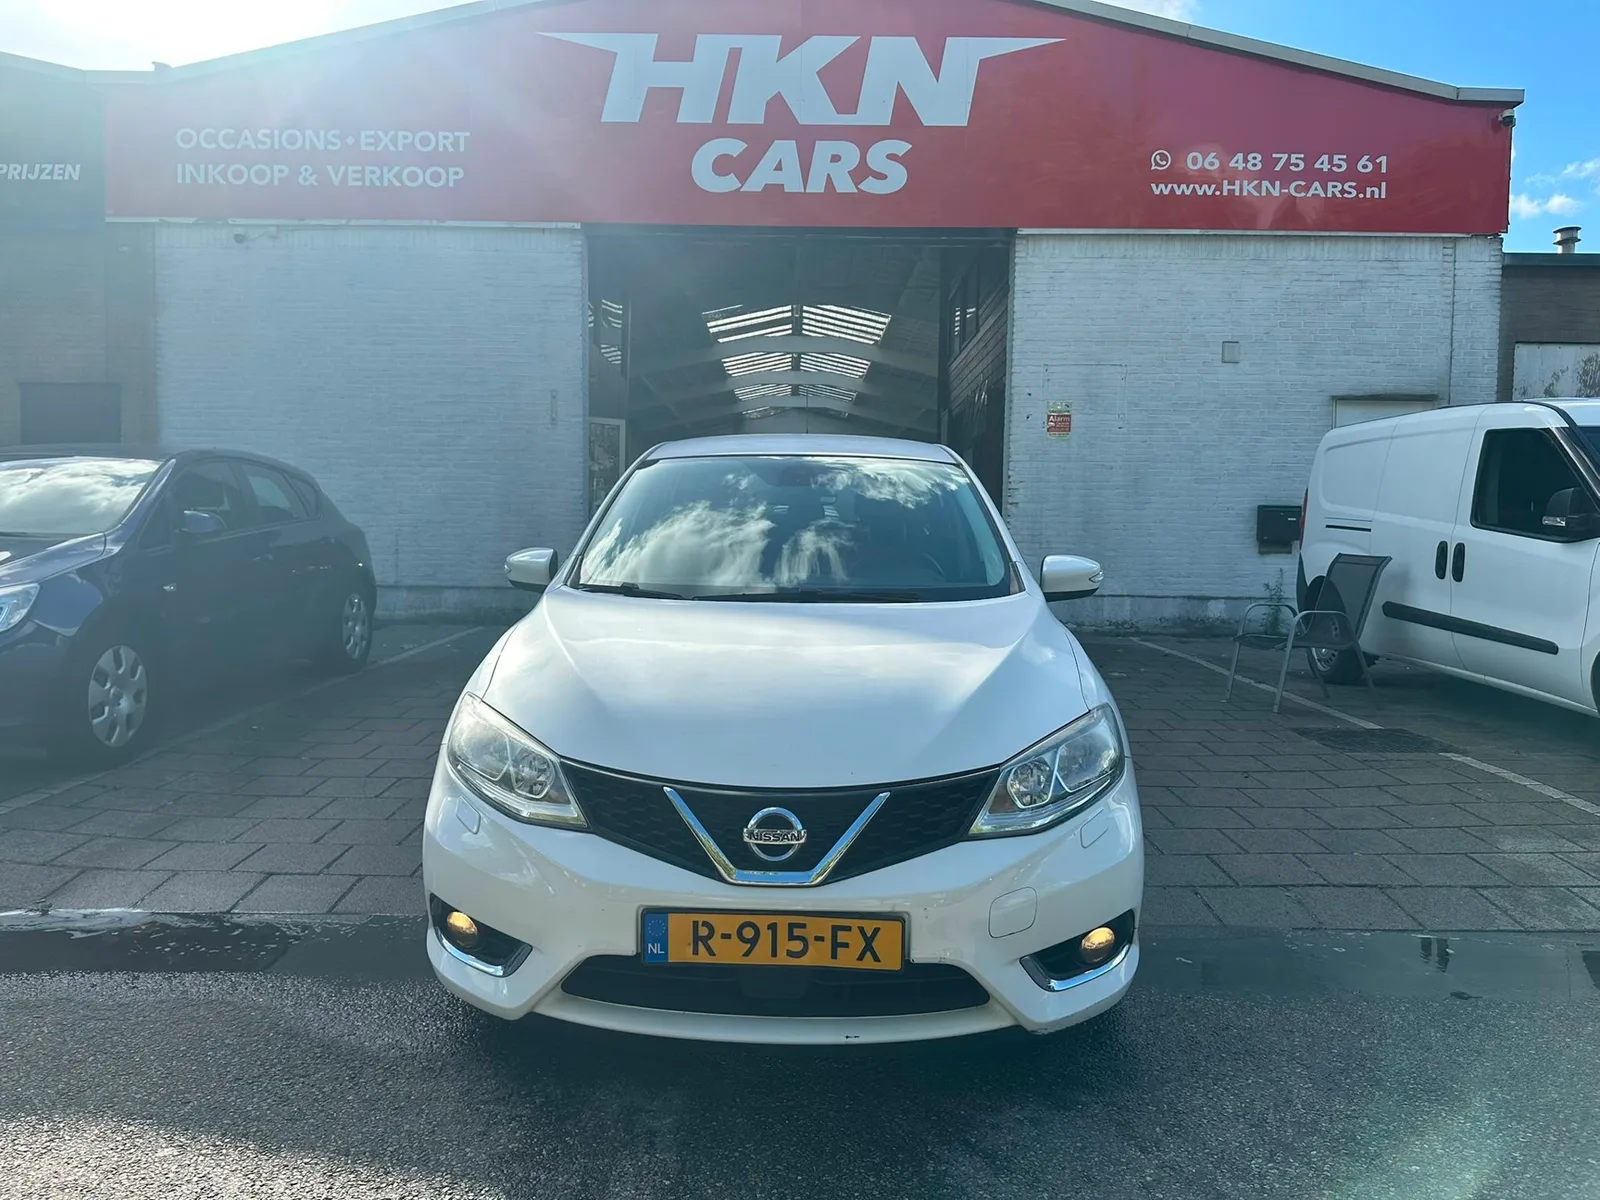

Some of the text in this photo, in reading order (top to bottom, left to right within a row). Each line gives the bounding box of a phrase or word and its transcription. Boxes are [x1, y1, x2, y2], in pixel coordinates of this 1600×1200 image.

[535, 32, 1068, 127] HKN
[175, 127, 470, 152] OCCASIONS EXPORT
[690, 137, 913, 195] CARS
[1186, 152, 1388, 173] 06 48 75 45 61
[176, 163, 465, 188] INKOOP & VERKOOP
[1150, 180, 1388, 199] www.HKN-CARS.nl
[749, 832, 800, 842] NISSAN
[648, 943, 665, 955] NL
[692, 920, 882, 963] R-915-FX
